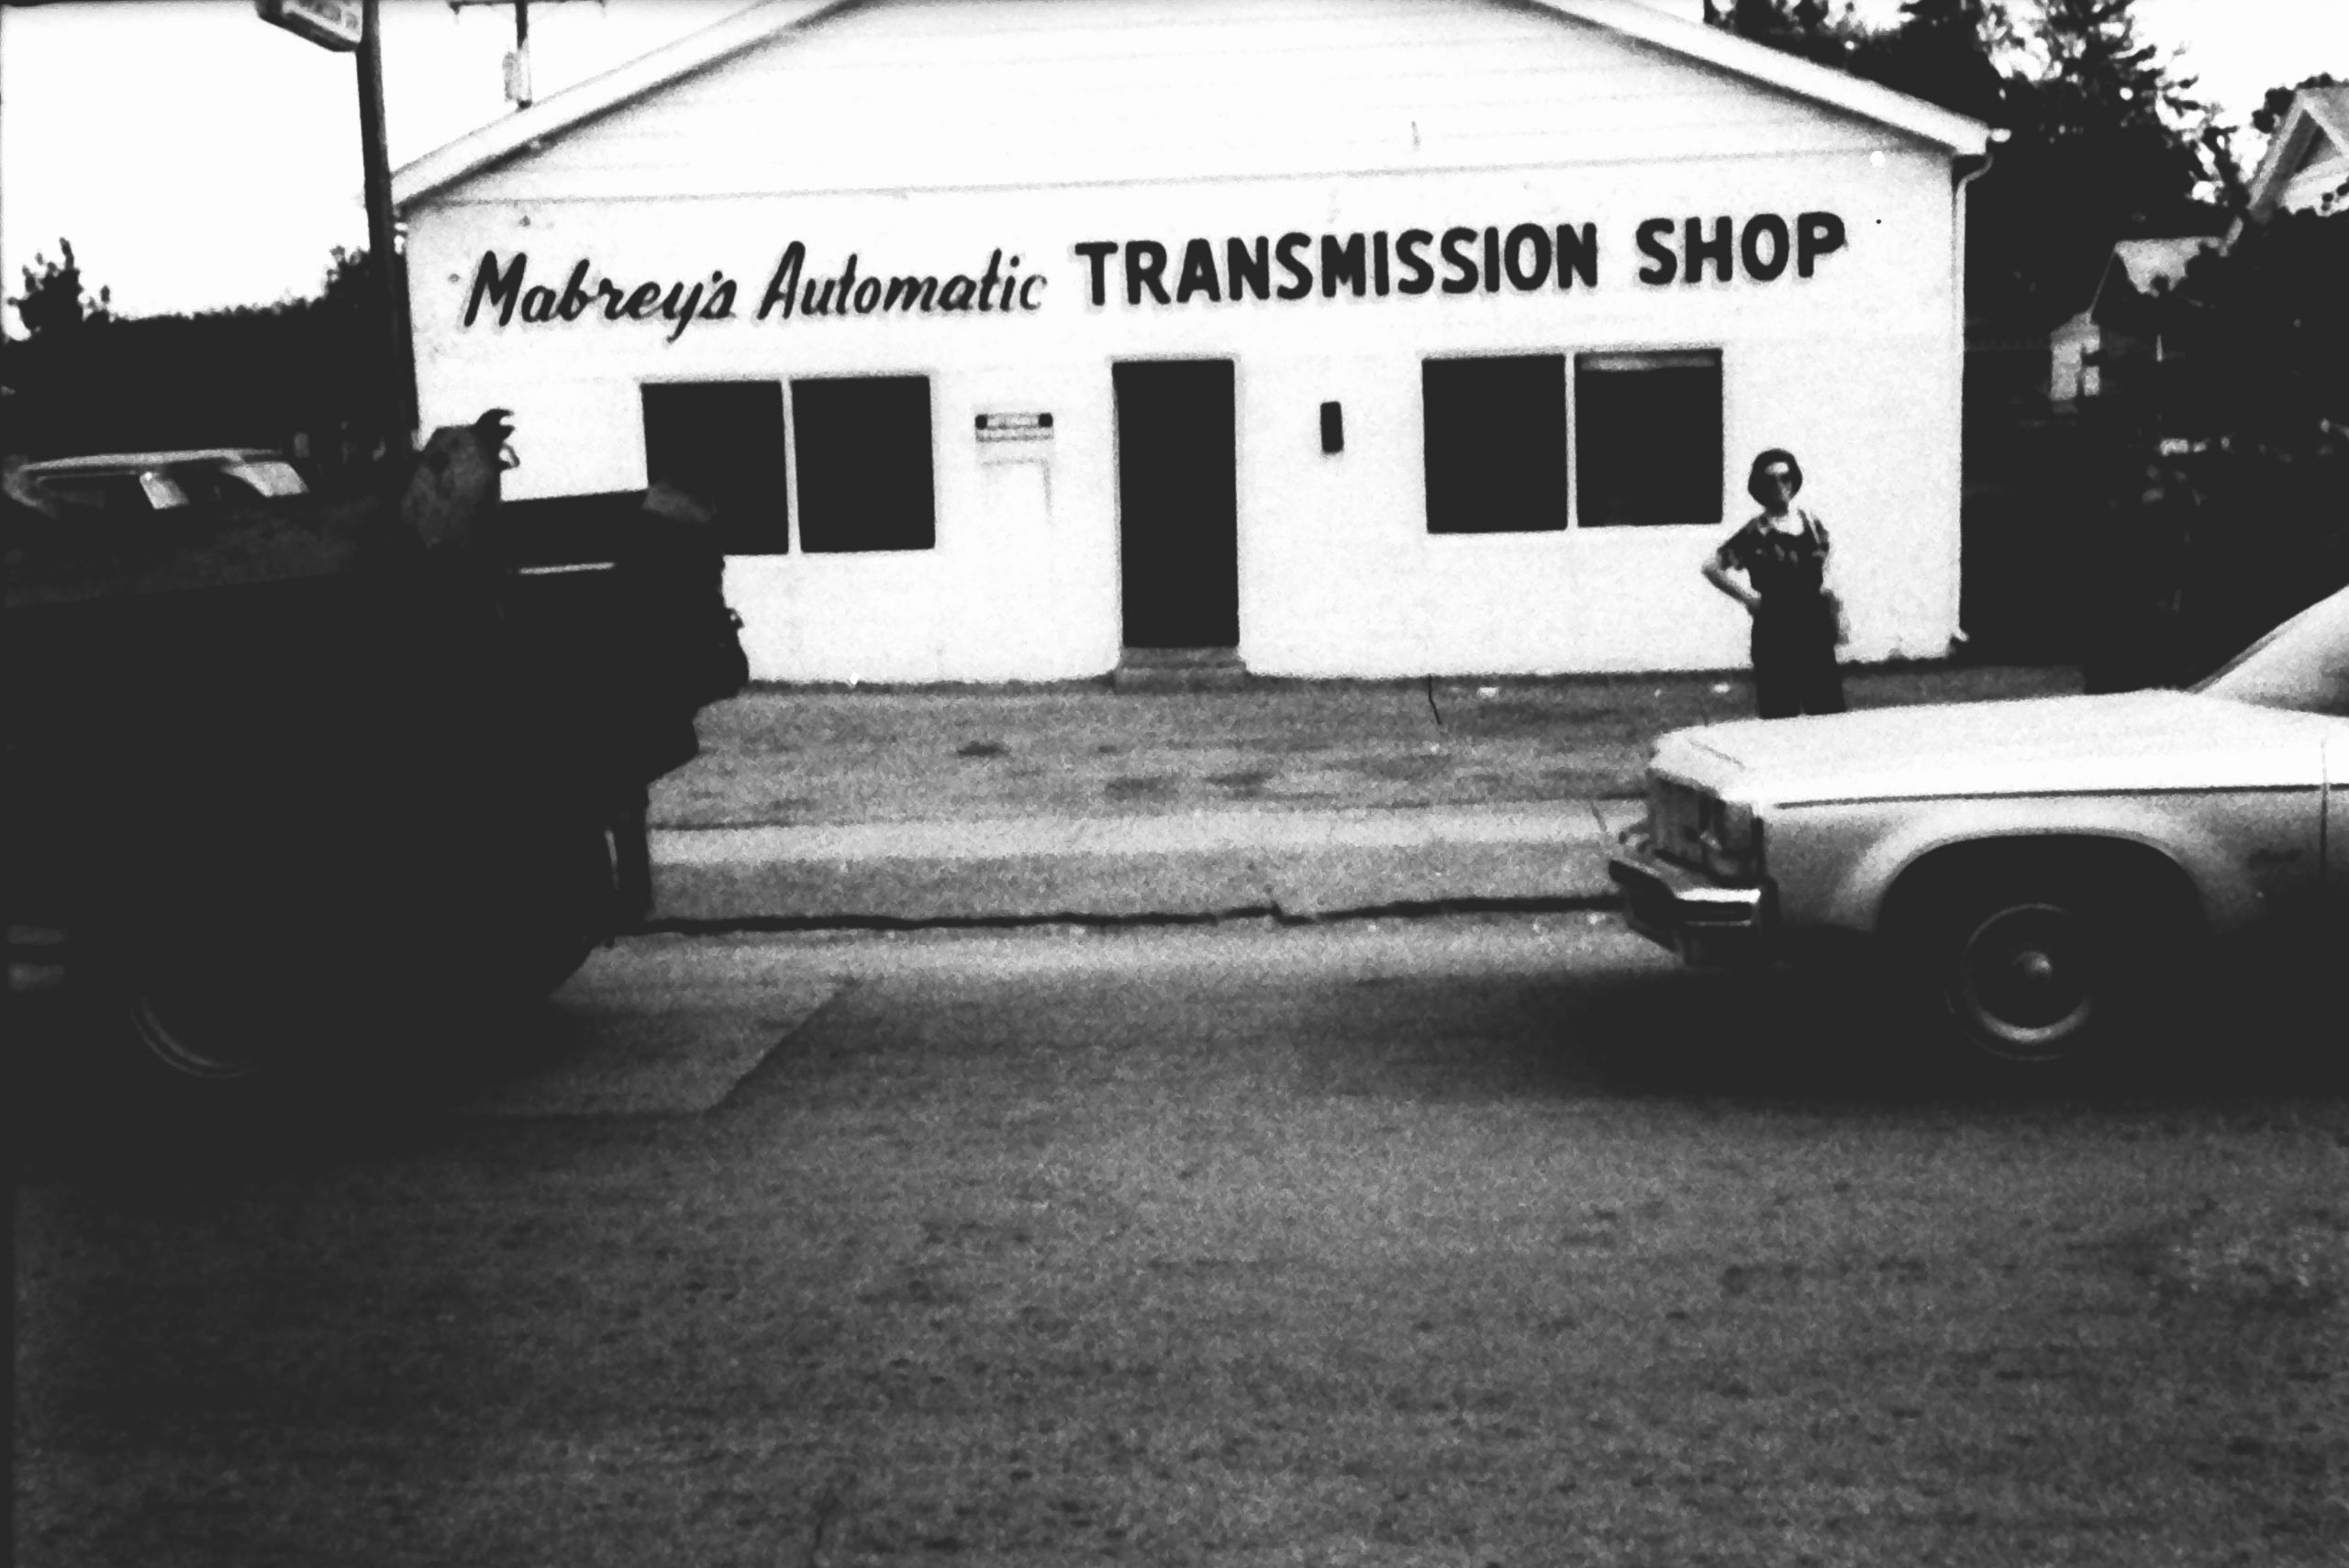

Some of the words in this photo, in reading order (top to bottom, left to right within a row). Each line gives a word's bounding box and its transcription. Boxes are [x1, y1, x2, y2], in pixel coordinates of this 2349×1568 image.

[463, 250, 739, 343] Mabrey's
[756, 240, 1047, 320] Automatic
[1074, 222, 1598, 307] TRANSMISSION
[1635, 211, 1847, 286] SHOP
